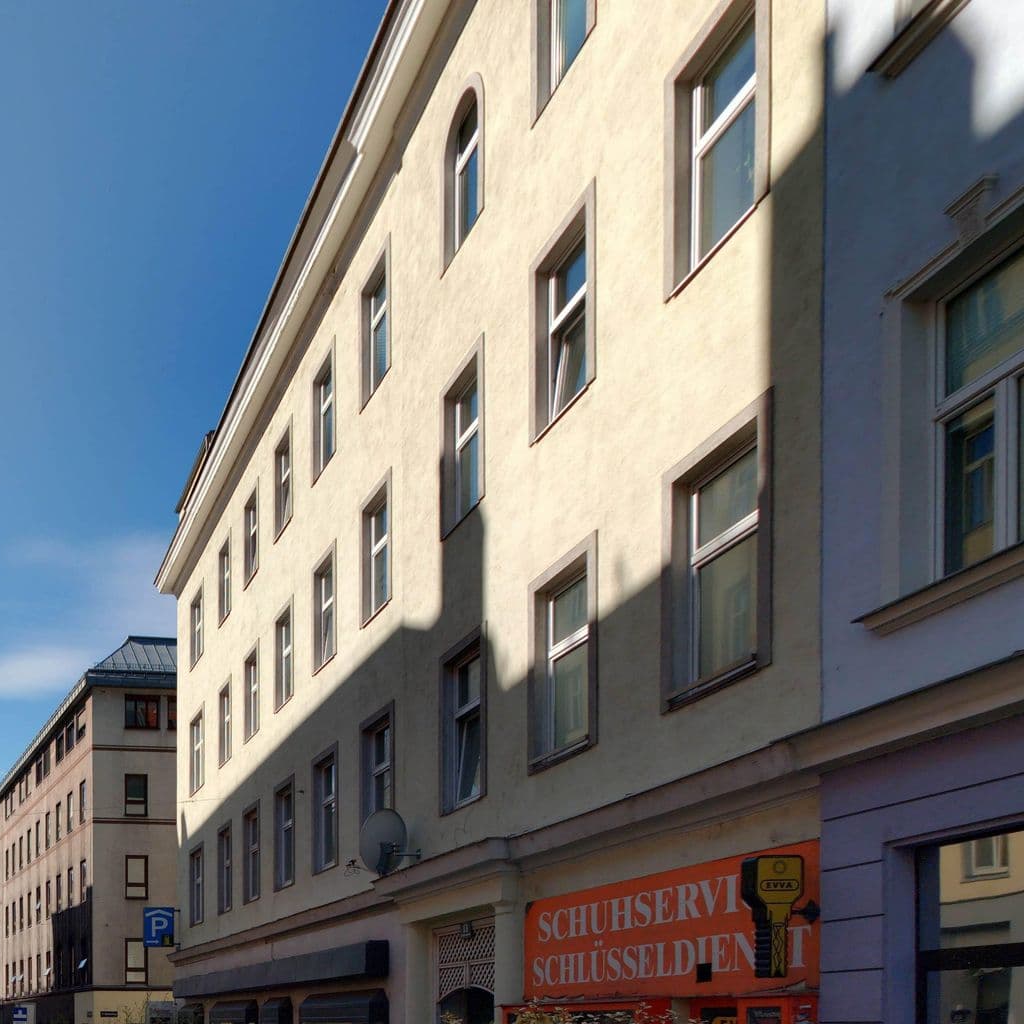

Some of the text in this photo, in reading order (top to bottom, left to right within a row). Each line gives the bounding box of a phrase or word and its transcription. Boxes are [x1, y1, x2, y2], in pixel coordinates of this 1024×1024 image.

[767, 881, 793, 889] EVVA
[151, 916, 168, 937] P
[537, 874, 753, 942] SCHUHSERVI
[531, 925, 812, 987] SCHLÜSSELDIENT
